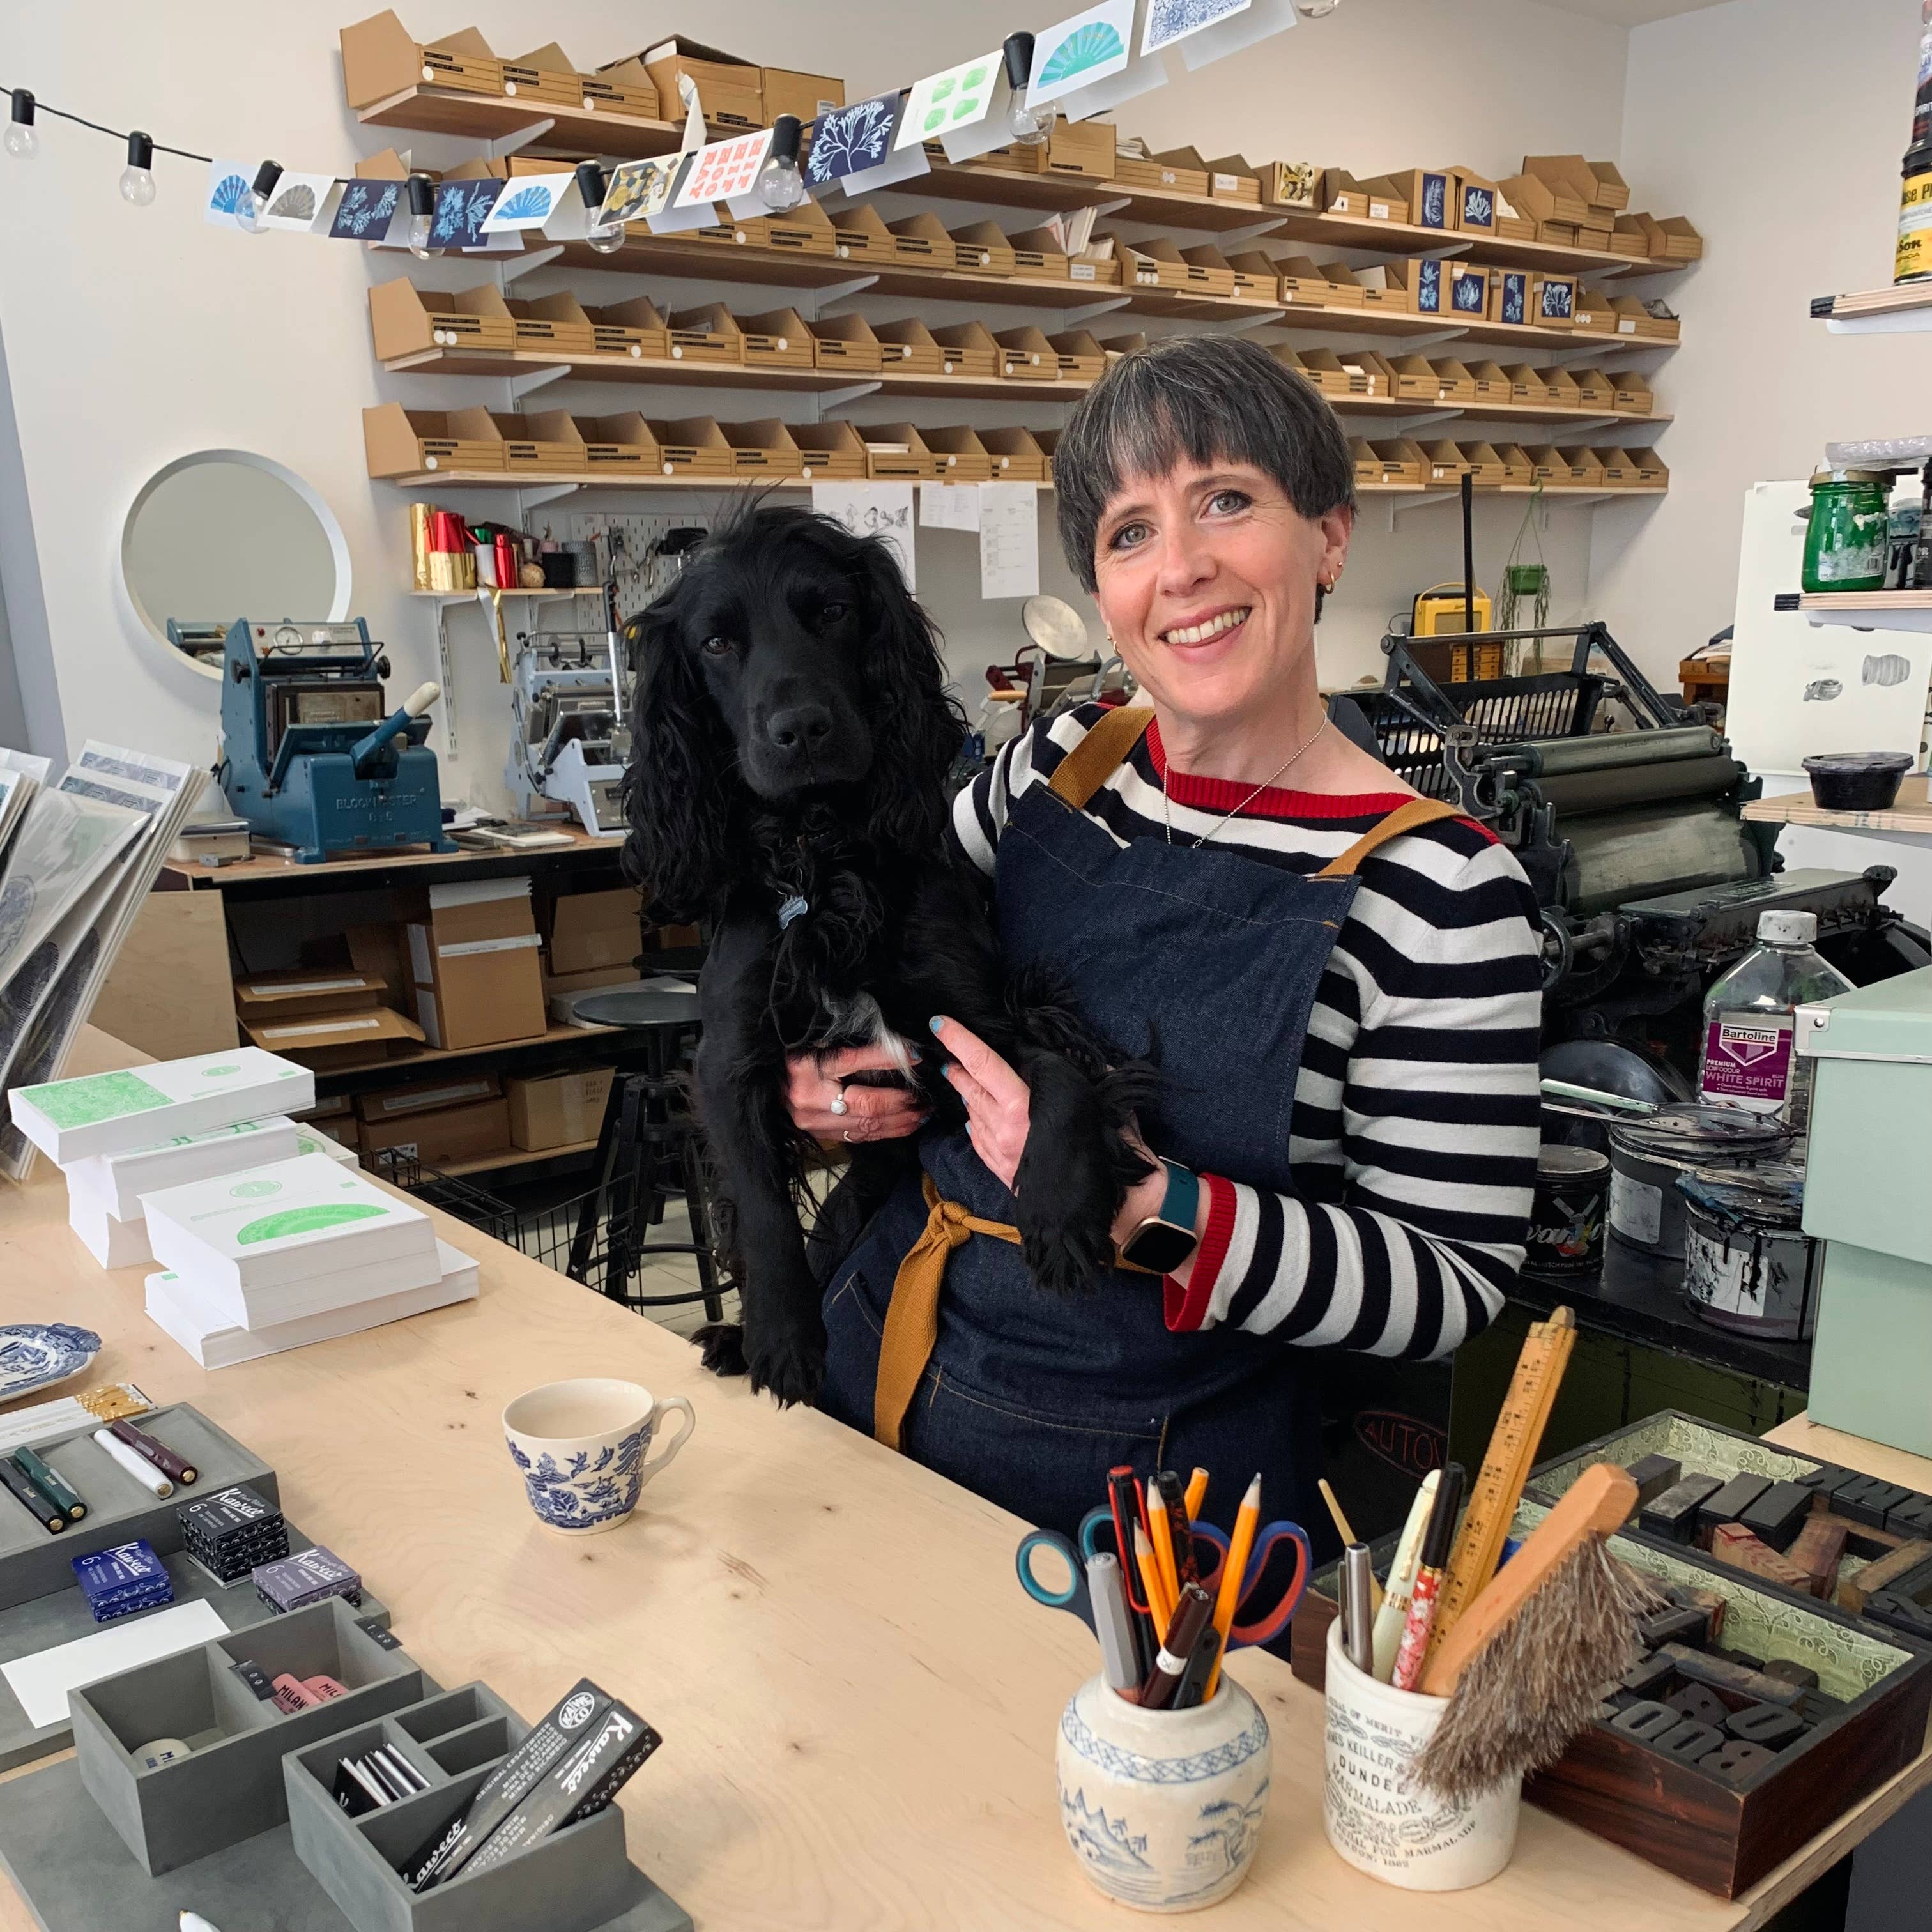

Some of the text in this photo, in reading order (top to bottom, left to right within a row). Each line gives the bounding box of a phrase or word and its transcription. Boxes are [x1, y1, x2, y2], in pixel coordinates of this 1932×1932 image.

[1722, 1029, 1775, 1042] Bartoline
[1706, 1059, 1736, 1068] PREMIUM
[1705, 1071, 1744, 1084] WHITE
[1745, 1076, 1784, 1088] SPIRIT
[188, 1503, 208, 1513] 6
[206, 1487, 265, 1517] Kaweco
[82, 1556, 102, 1566] 6
[103, 1541, 151, 1574] Kaweco
[266, 1565, 285, 1574] 6
[284, 1548, 343, 1579] Kaweco
[277, 1683, 307, 1710] MILAN
[1350, 1708, 1361, 1721] OF
[1365, 1714, 1402, 1738] MERIT
[528, 1725, 555, 1753] REFILLS
[561, 1710, 633, 1795] Kaweco
[475, 1721, 551, 1801] ORIGINAL ERSATZMINEN
[500, 1733, 564, 1799] MINA DE RECAMBIO
[507, 1736, 568, 1800] MINA DI RICAMBIO
[1347, 1738, 1394, 1770] KEILLER
[501, 1769, 521, 1790] MINE
[519, 1759, 531, 1770] DE
[1339, 1754, 1406, 1795] DUNDEE
[500, 1814, 520, 1835] MINA
[507, 1815, 528, 1837] MINA
[496, 1825, 526, 1857] MINE DE
[497, 1835, 509, 1847] DE
[1373, 1844, 1397, 1858] FOR
